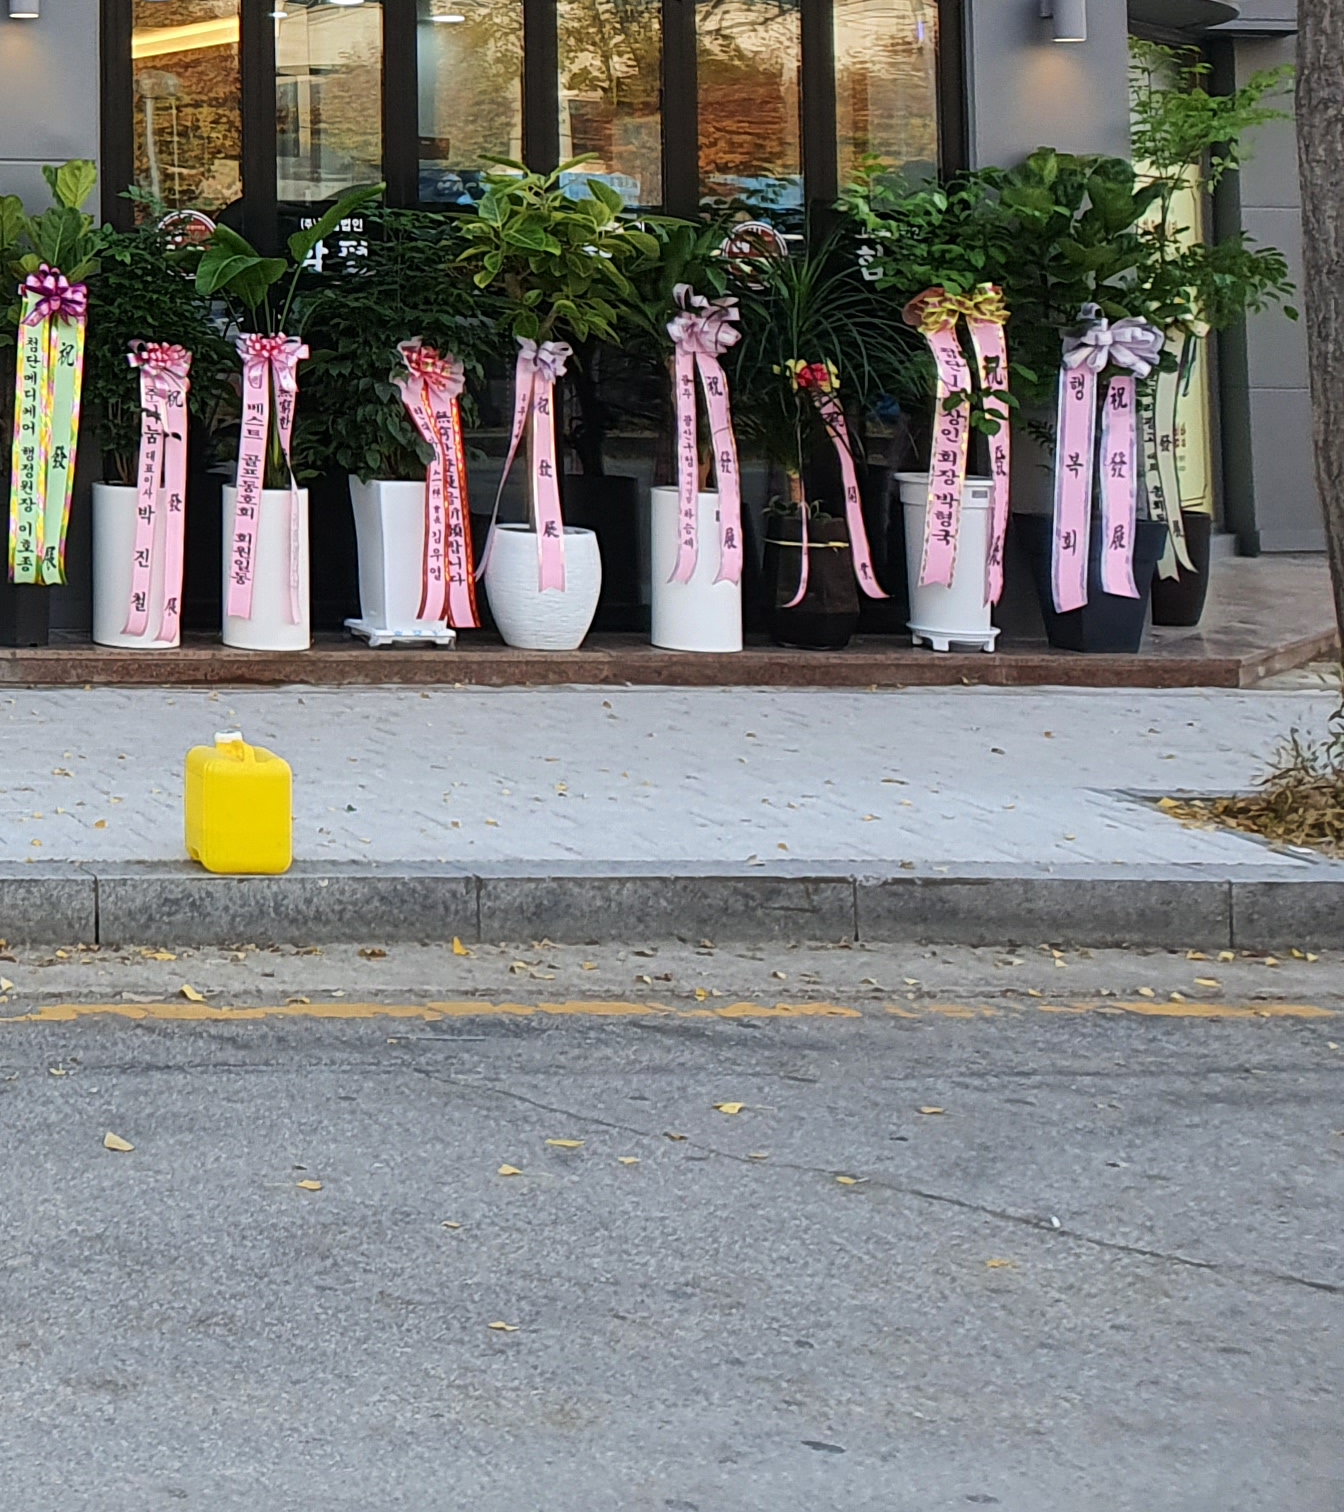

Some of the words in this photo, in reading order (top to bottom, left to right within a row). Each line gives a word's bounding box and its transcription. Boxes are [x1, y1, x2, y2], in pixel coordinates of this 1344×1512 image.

[22, 337, 41, 436] 첨단메디케어
[245, 402, 265, 441] 베스트
[18, 447, 40, 513] 행정원장
[142, 451, 156, 498] 대표이사
[237, 454, 261, 521] 골프동호회
[936, 449, 958, 484] 회장
[1060, 374, 1086, 554] 행복회
[931, 491, 958, 546] 박형국
[131, 504, 156, 612] 박진철
